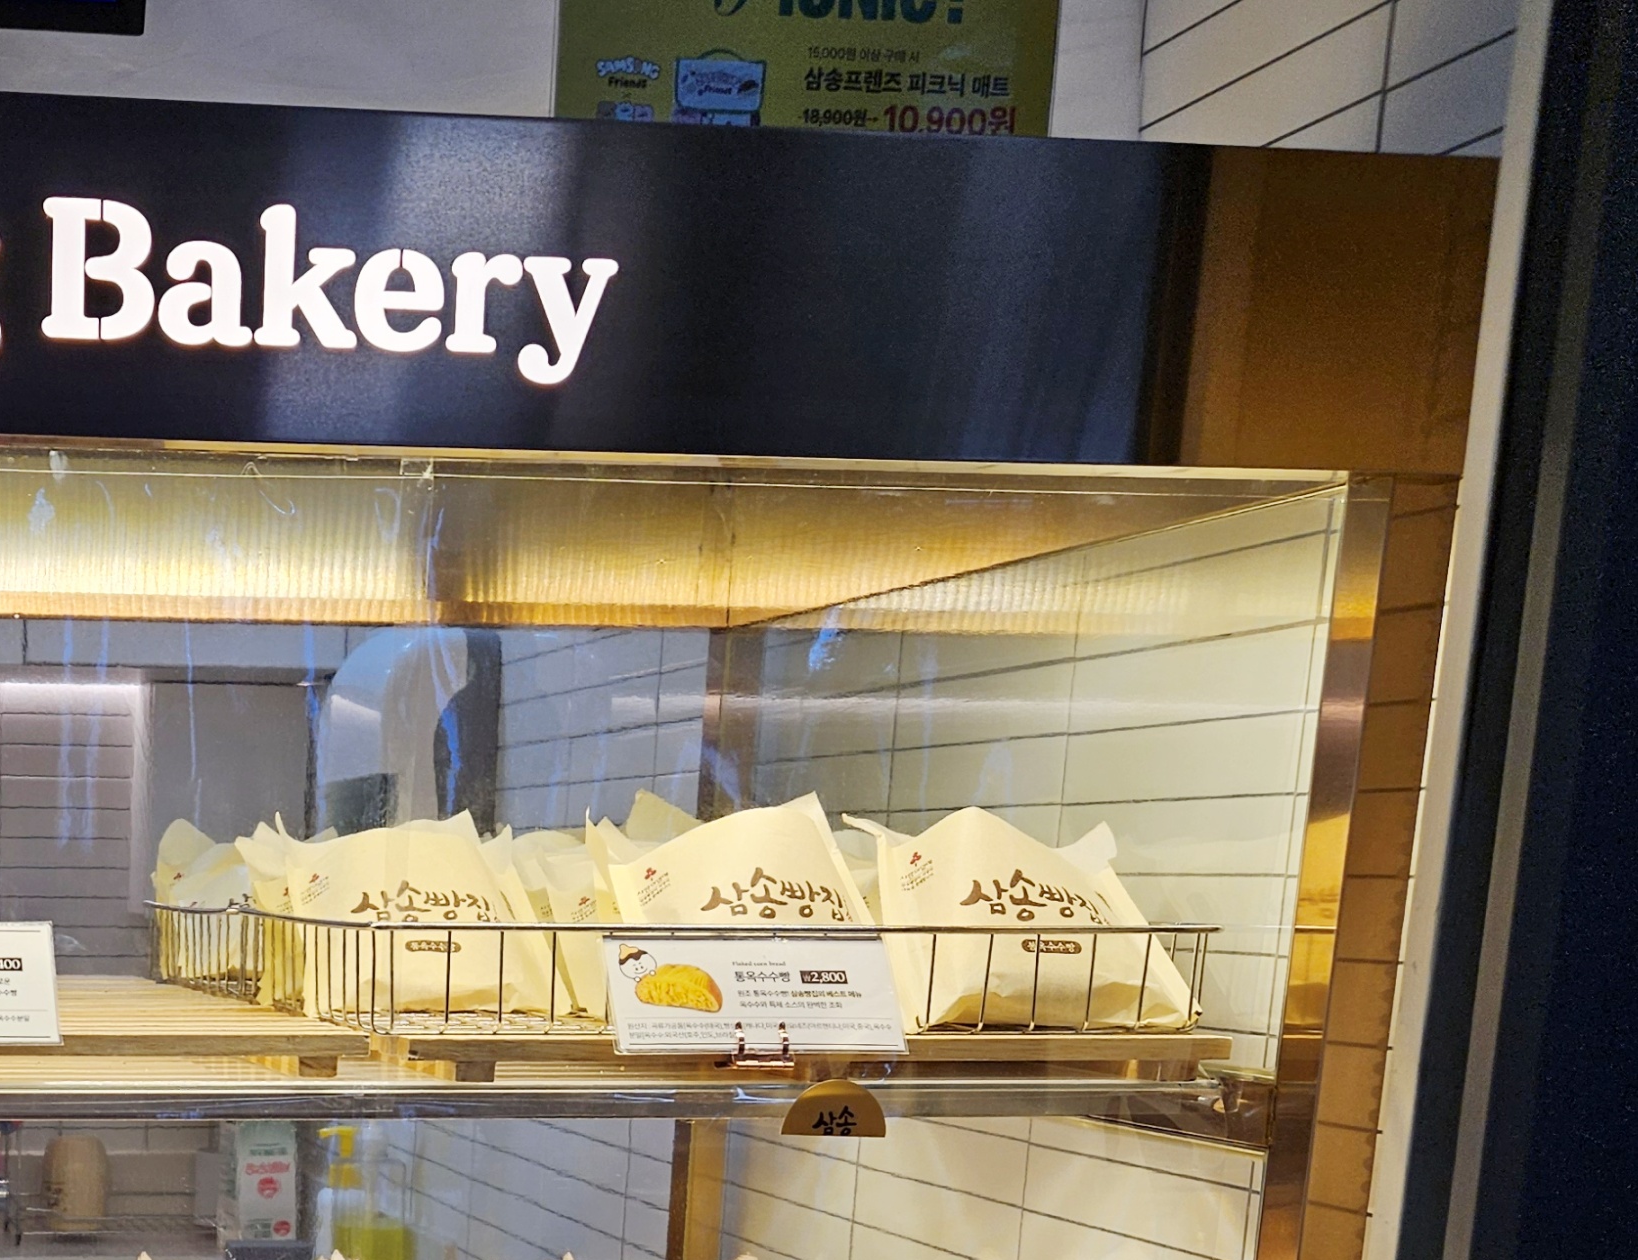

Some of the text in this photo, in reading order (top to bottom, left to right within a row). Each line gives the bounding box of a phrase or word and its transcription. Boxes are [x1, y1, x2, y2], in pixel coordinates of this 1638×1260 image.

[803, 67, 1010, 98] 삼송프렌즈 피크닉 매트
[41, 196, 619, 386] Bakery
[350, 880, 491, 922] 삼송빵집
[701, 867, 845, 921] 삼송빵집
[960, 869, 1099, 925] 삼송빵집
[735, 971, 846, 984] 통옥수수빵 ₩2,800
[812, 1105, 857, 1136] 삼송
